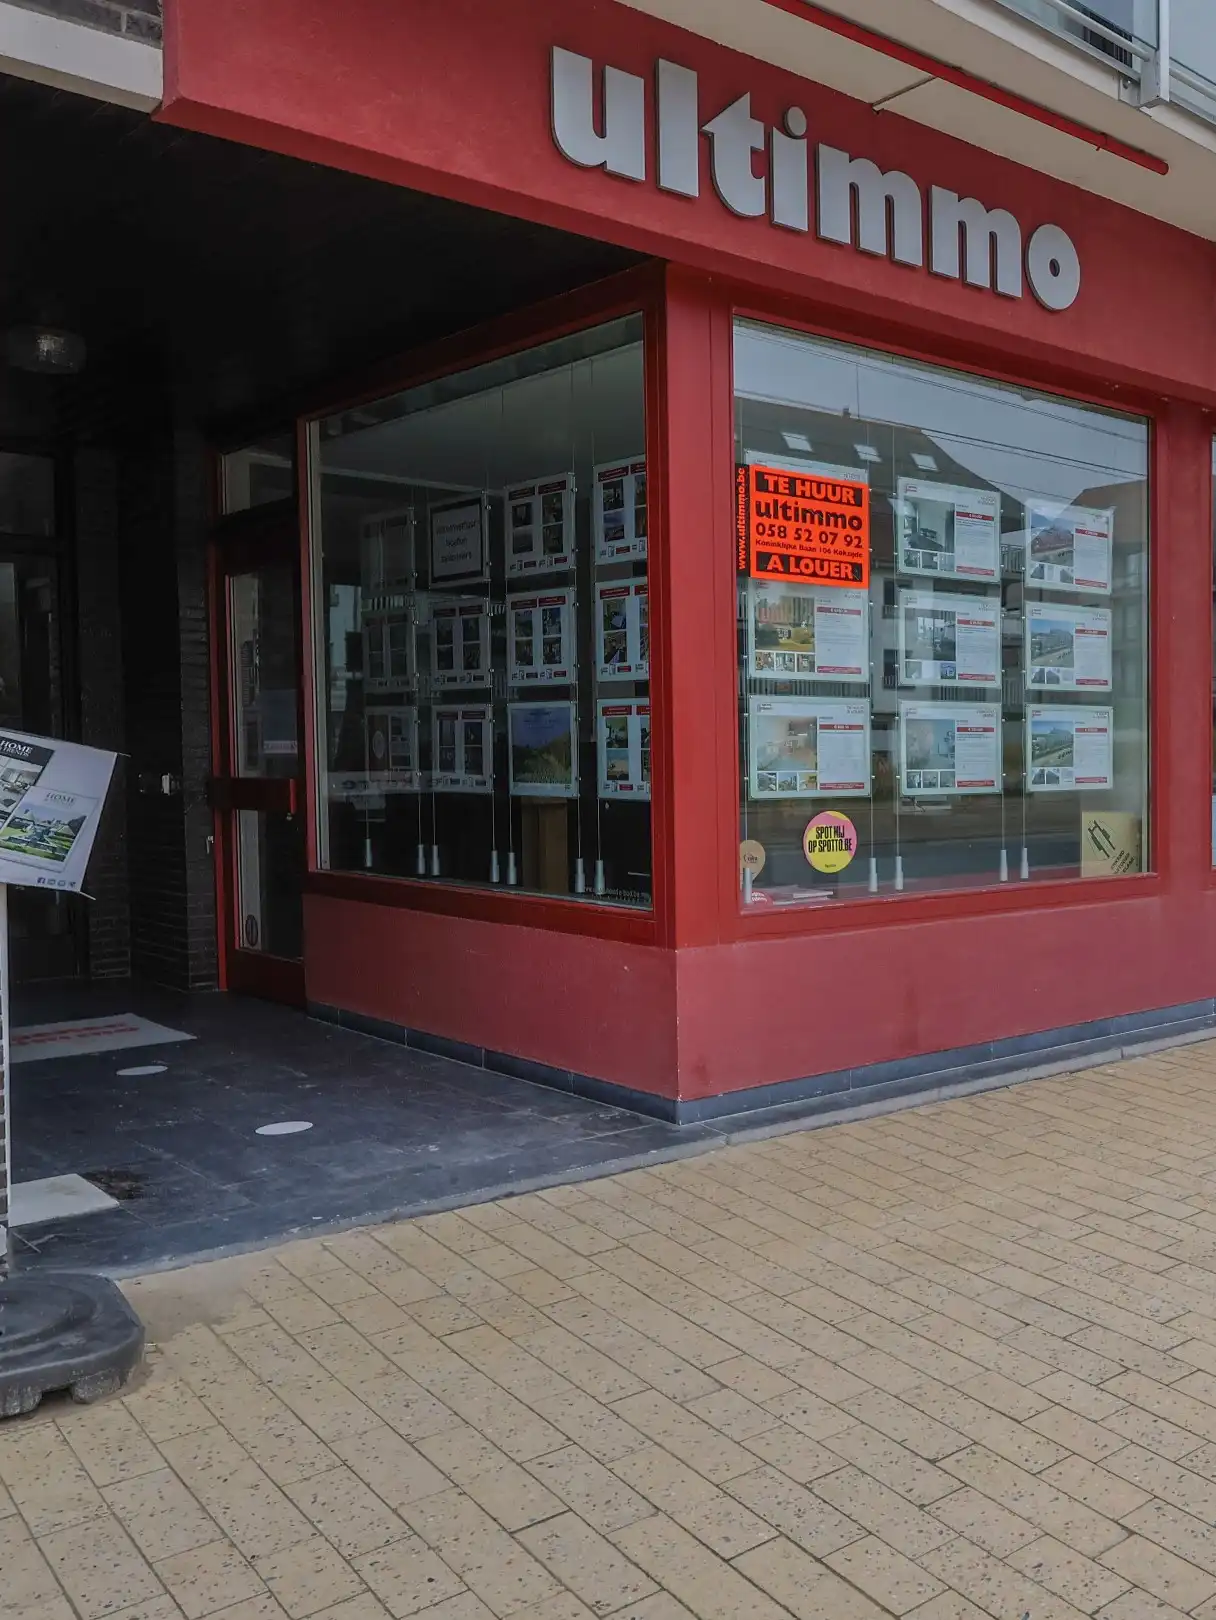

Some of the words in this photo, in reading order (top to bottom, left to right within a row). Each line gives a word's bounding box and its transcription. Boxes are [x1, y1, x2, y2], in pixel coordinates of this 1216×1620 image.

[550, 45, 1081, 312] ultimmo
[763, 474, 790, 494] TE
[795, 479, 856, 505] HUUR
[736, 467, 746, 570] www.ultimmo.be
[755, 499, 863, 531] ultimmo
[755, 522, 787, 539] 058
[793, 529, 813, 543] 52
[818, 532, 838, 546] 07
[843, 534, 863, 549] 92
[766, 555, 784, 571] A
[789, 557, 854, 579] LOUER
[0, 740, 33, 754] HOME
[808, 840, 818, 854] OP
[818, 838, 852, 853] SPOTTO.BE
[815, 825, 833, 840] SPOT
[833, 825, 845, 839] MIJ
